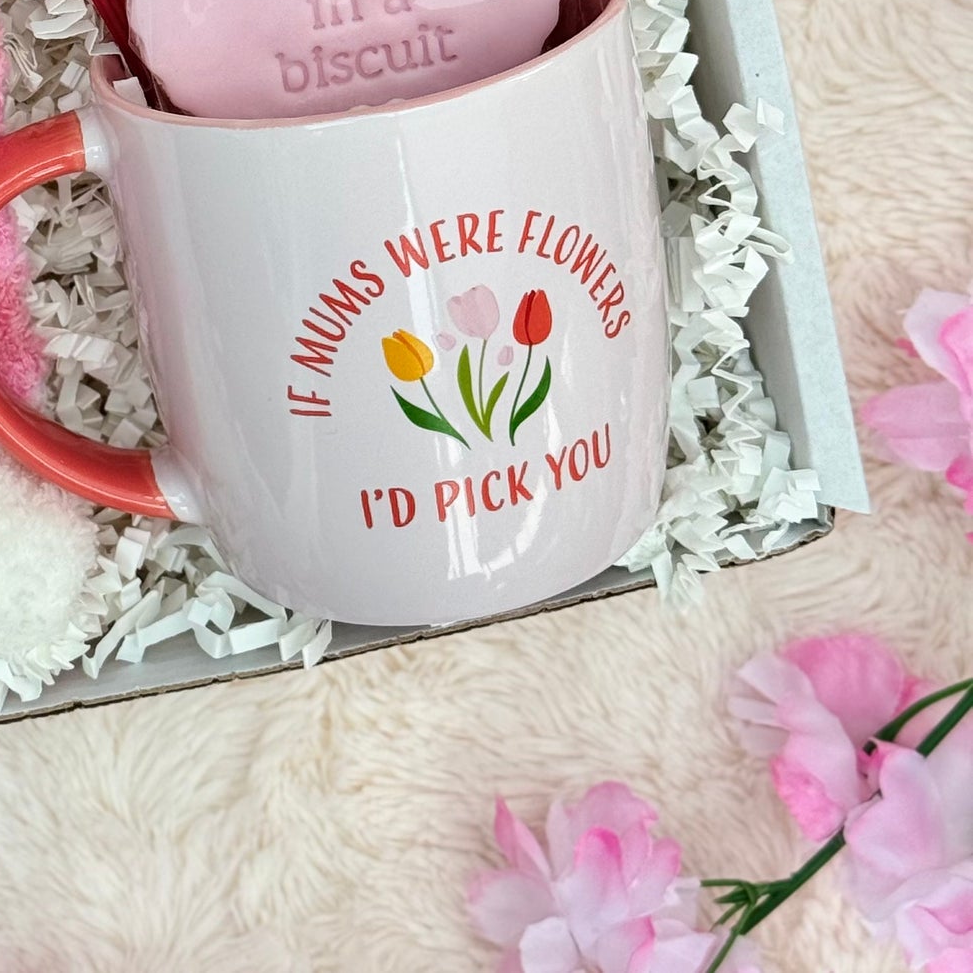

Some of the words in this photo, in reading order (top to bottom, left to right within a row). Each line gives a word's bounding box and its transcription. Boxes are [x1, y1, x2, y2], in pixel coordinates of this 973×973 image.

[275, 22, 458, 94] biscuit
[384, 208, 505, 278] WERE
[517, 209, 632, 340] FLOWERS
[289, 259, 386, 377] MUMS
[286, 384, 333, 417] IF
[360, 486, 416, 530] I'D
[433, 460, 534, 523] PICK
[544, 421, 612, 491] YOU
